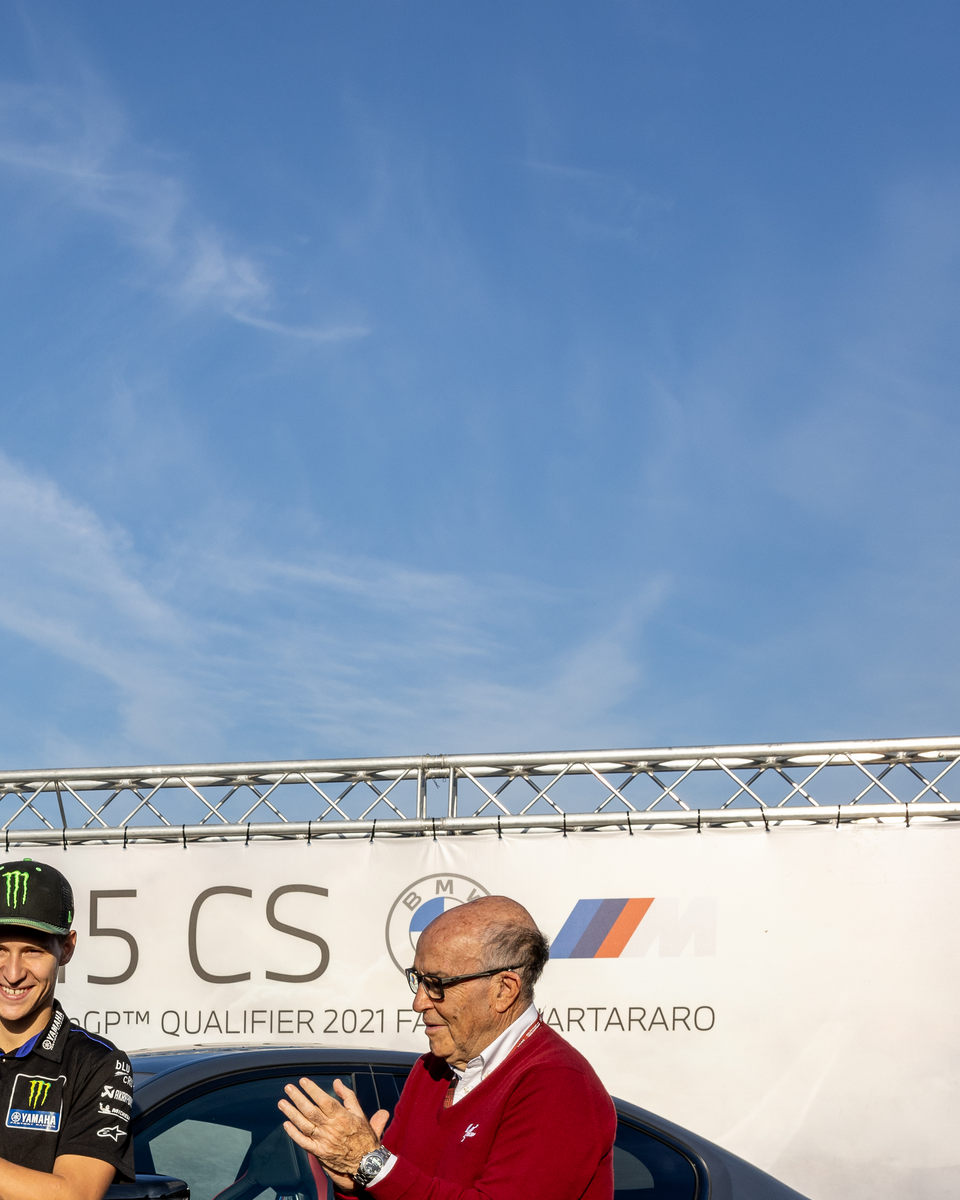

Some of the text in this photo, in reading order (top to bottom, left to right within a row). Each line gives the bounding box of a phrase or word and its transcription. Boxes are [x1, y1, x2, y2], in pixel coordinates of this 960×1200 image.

[188, 883, 330, 984] CS
[46, 1010, 65, 1041] YAMAHA
[161, 1009, 315, 1037] QUALIFIER
[323, 1009, 385, 1034] 2021
[539, 1006, 715, 1032] ARTARARO
[22, 1113, 56, 1126] YAMAHA
